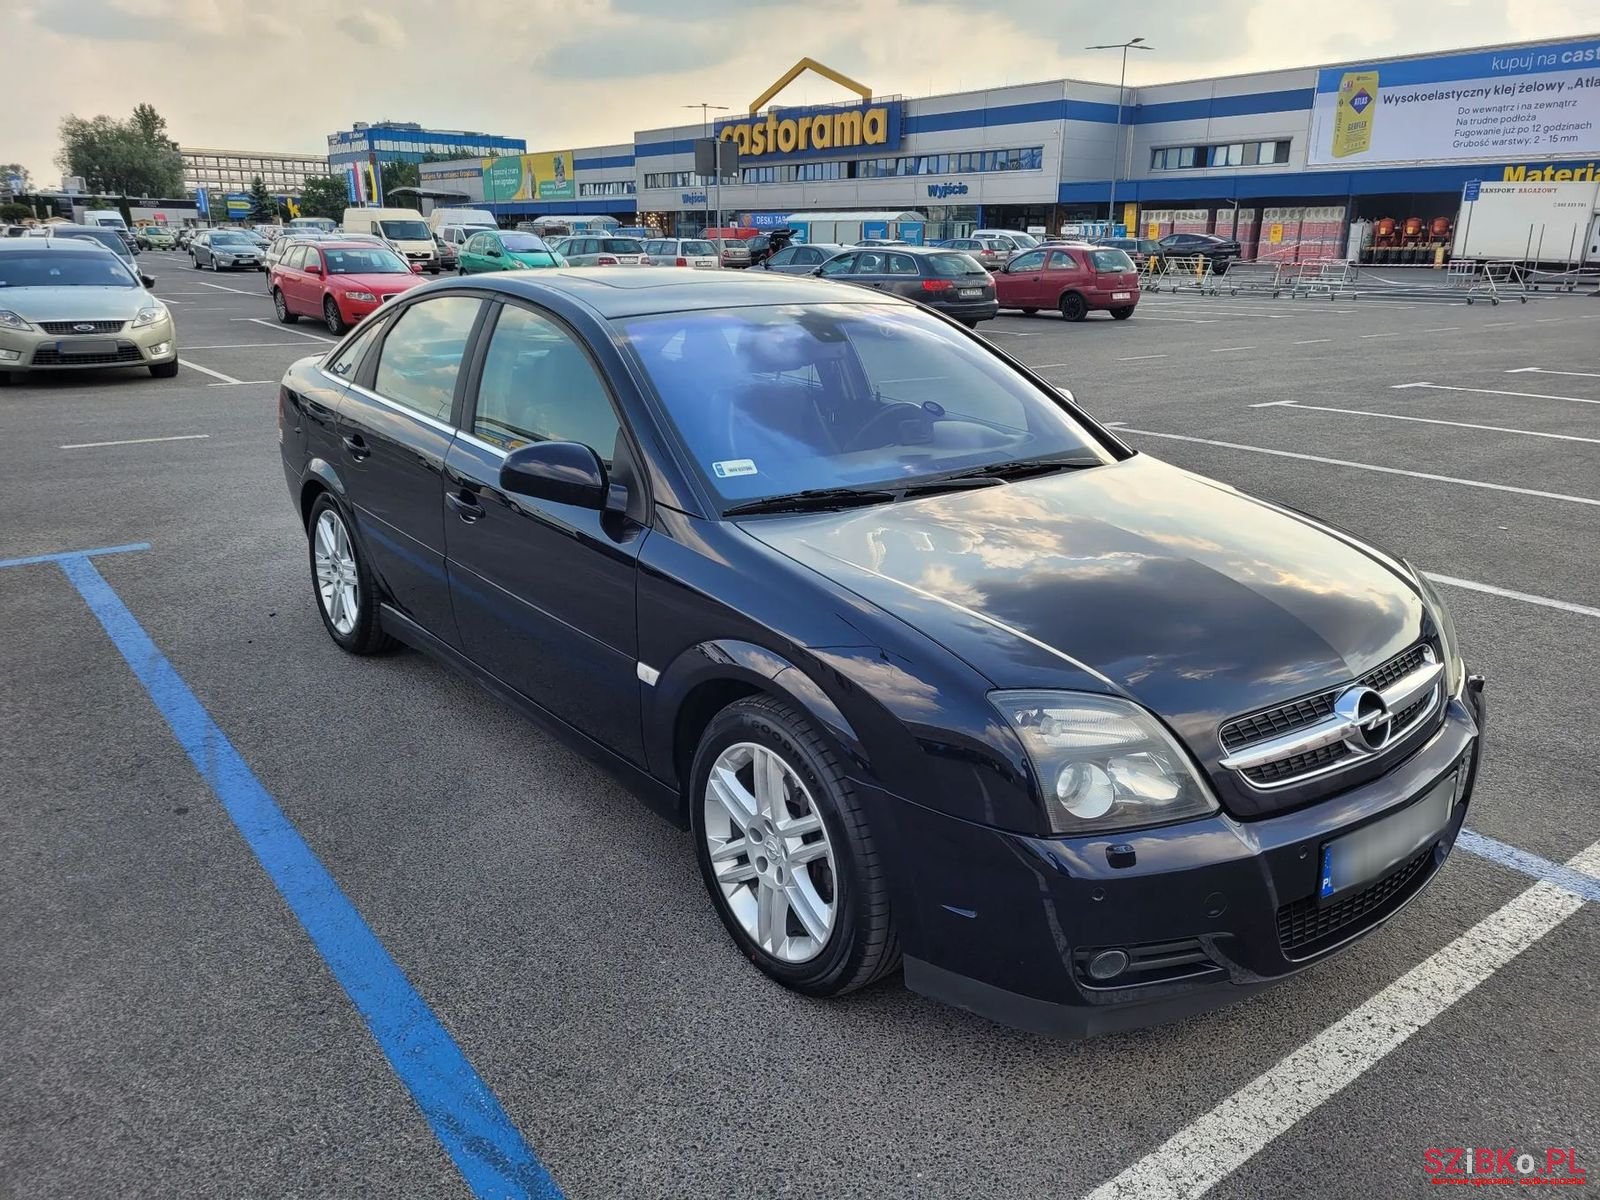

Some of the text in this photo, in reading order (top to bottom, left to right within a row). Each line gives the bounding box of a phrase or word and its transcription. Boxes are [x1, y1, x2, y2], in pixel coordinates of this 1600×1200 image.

[1491, 53, 1533, 73] kupuj
[1537, 54, 1557, 66] na
[1383, 85, 1491, 106] Wysokoelastyczny
[1494, 84, 1516, 97] klej
[1518, 79, 1566, 95] żelowy
[1458, 107, 1470, 115] Do
[1472, 103, 1515, 115] wewnątrz
[1534, 99, 1578, 110] zewnątrz
[1456, 114, 1536, 126] Na trudne podłoża
[1454, 121, 1592, 139] Fugowanie już po 12 godzinach
[1452, 138, 1490, 149] Grubość
[1534, 135, 1541, 144] 2
[1549, 134, 1558, 143] 15
[1560, 134, 1578, 142] mm
[927, 181, 969, 199] Wyjście
[775, 215, 791, 225] TAR
